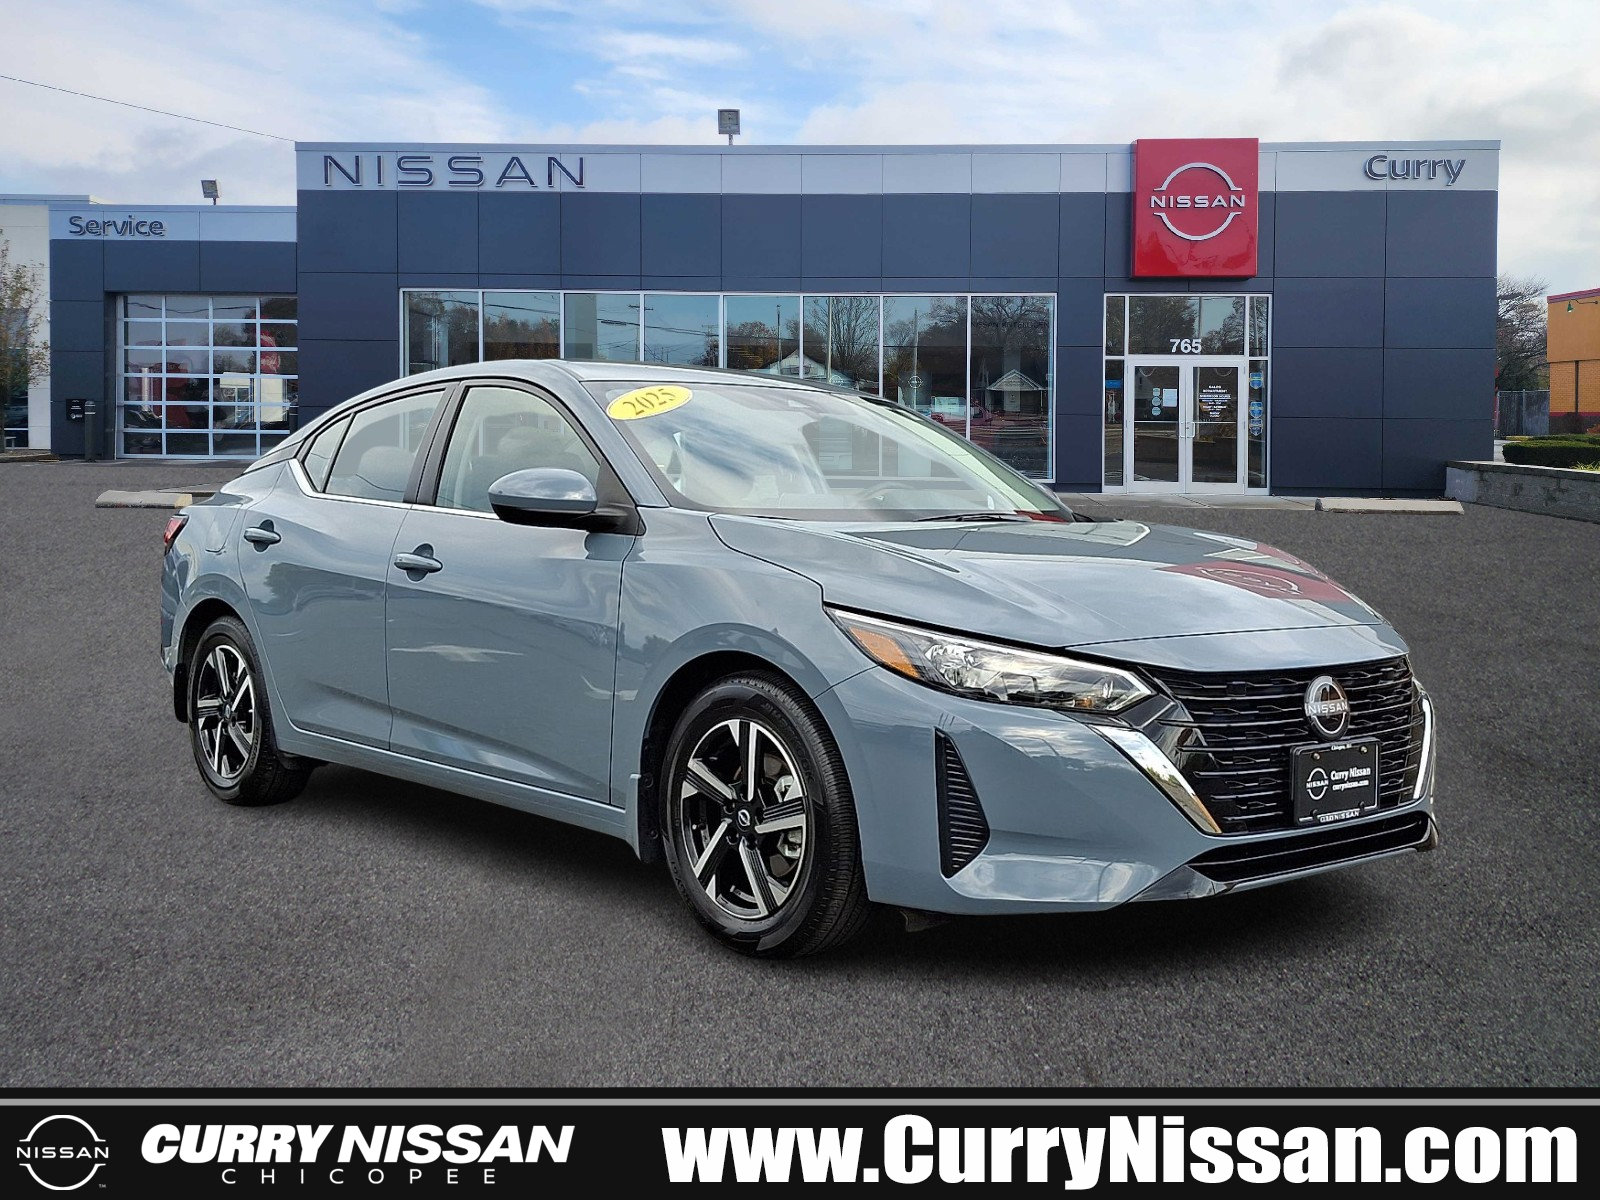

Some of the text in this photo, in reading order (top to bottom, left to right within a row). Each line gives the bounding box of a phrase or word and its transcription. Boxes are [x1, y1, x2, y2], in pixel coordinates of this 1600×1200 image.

[323, 155, 585, 188] NISSAN
[1364, 154, 1466, 186] Curry
[1150, 194, 1245, 209] NISSAN
[68, 214, 165, 236] Service
[1169, 338, 1202, 354] 765
[622, 388, 676, 416] 2025
[1308, 701, 1348, 714] NISSAN
[1330, 766, 1371, 781] Curry Nissan
[1306, 780, 1328, 789] NISSAN
